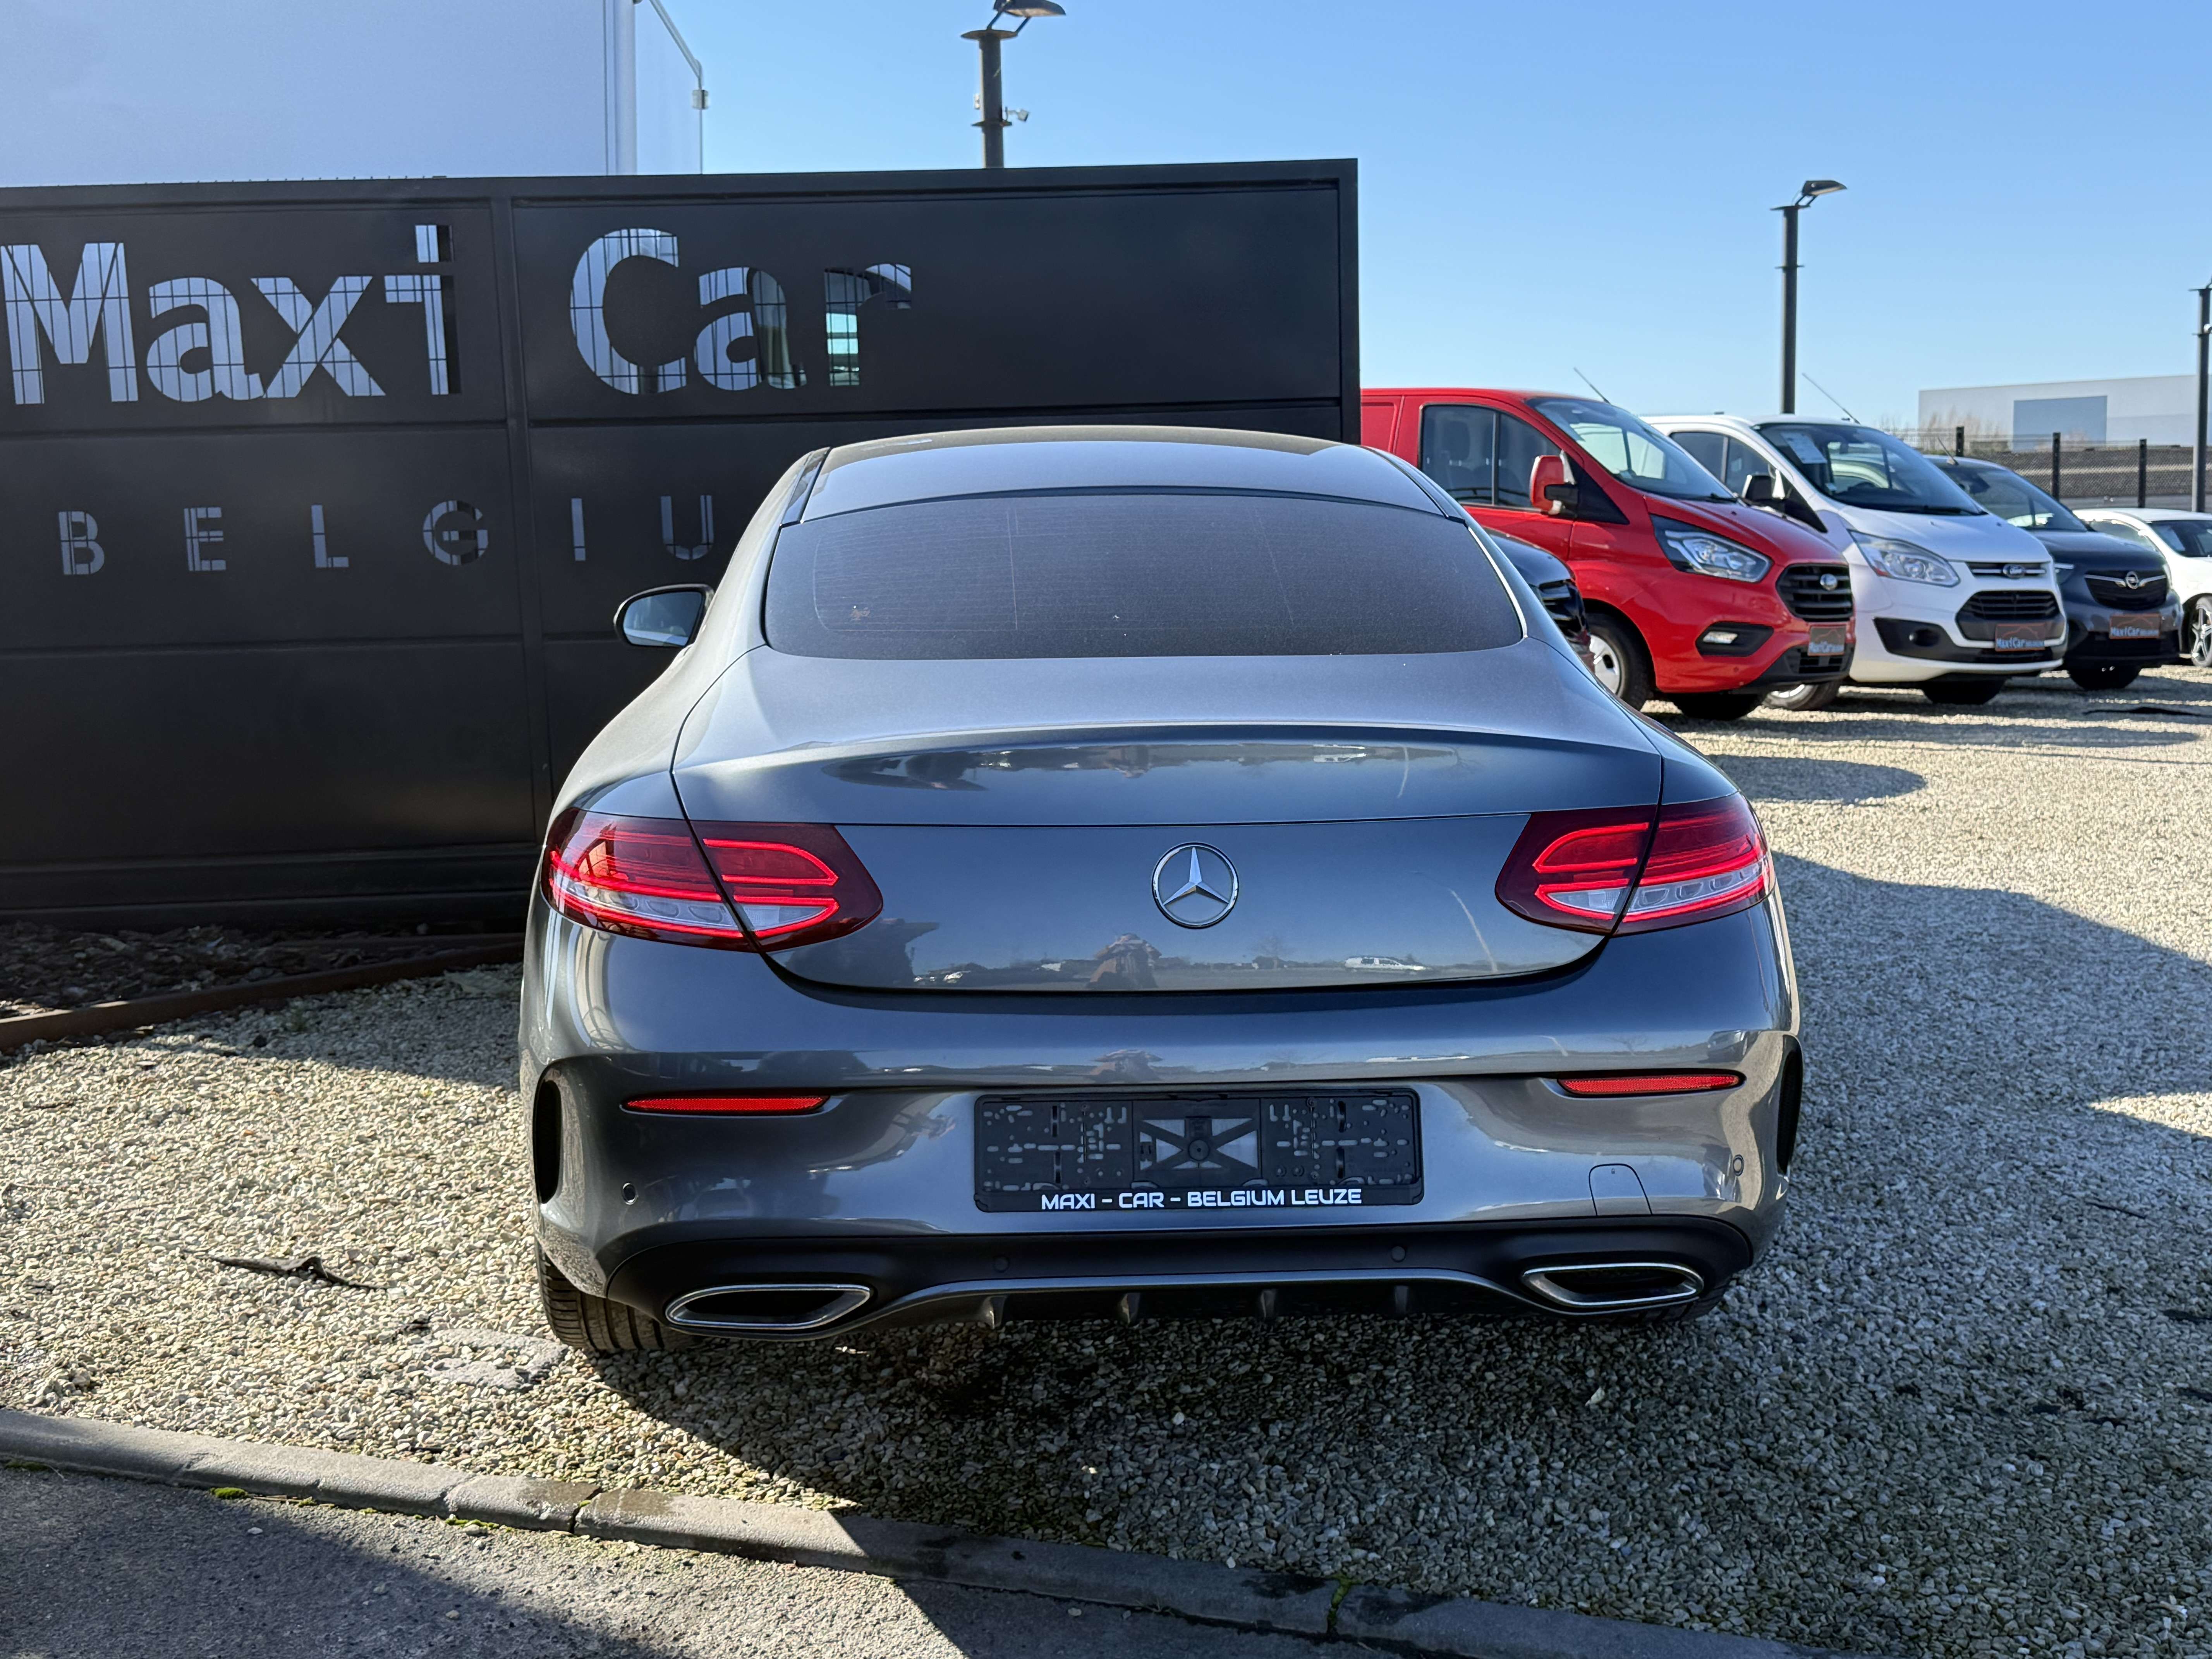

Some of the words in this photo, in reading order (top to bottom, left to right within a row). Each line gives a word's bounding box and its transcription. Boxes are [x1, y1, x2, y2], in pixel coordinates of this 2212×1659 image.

[1, 225, 460, 404] Maxi
[570, 228, 912, 395] Car
[58, 495, 714, 575] BELGIU
[1041, 1194, 1095, 1209] MAXI
[1119, 1192, 1164, 1208] CAR
[1187, 1190, 1284, 1207] BELGIUM
[1291, 1188, 1362, 1205] LEUZE
